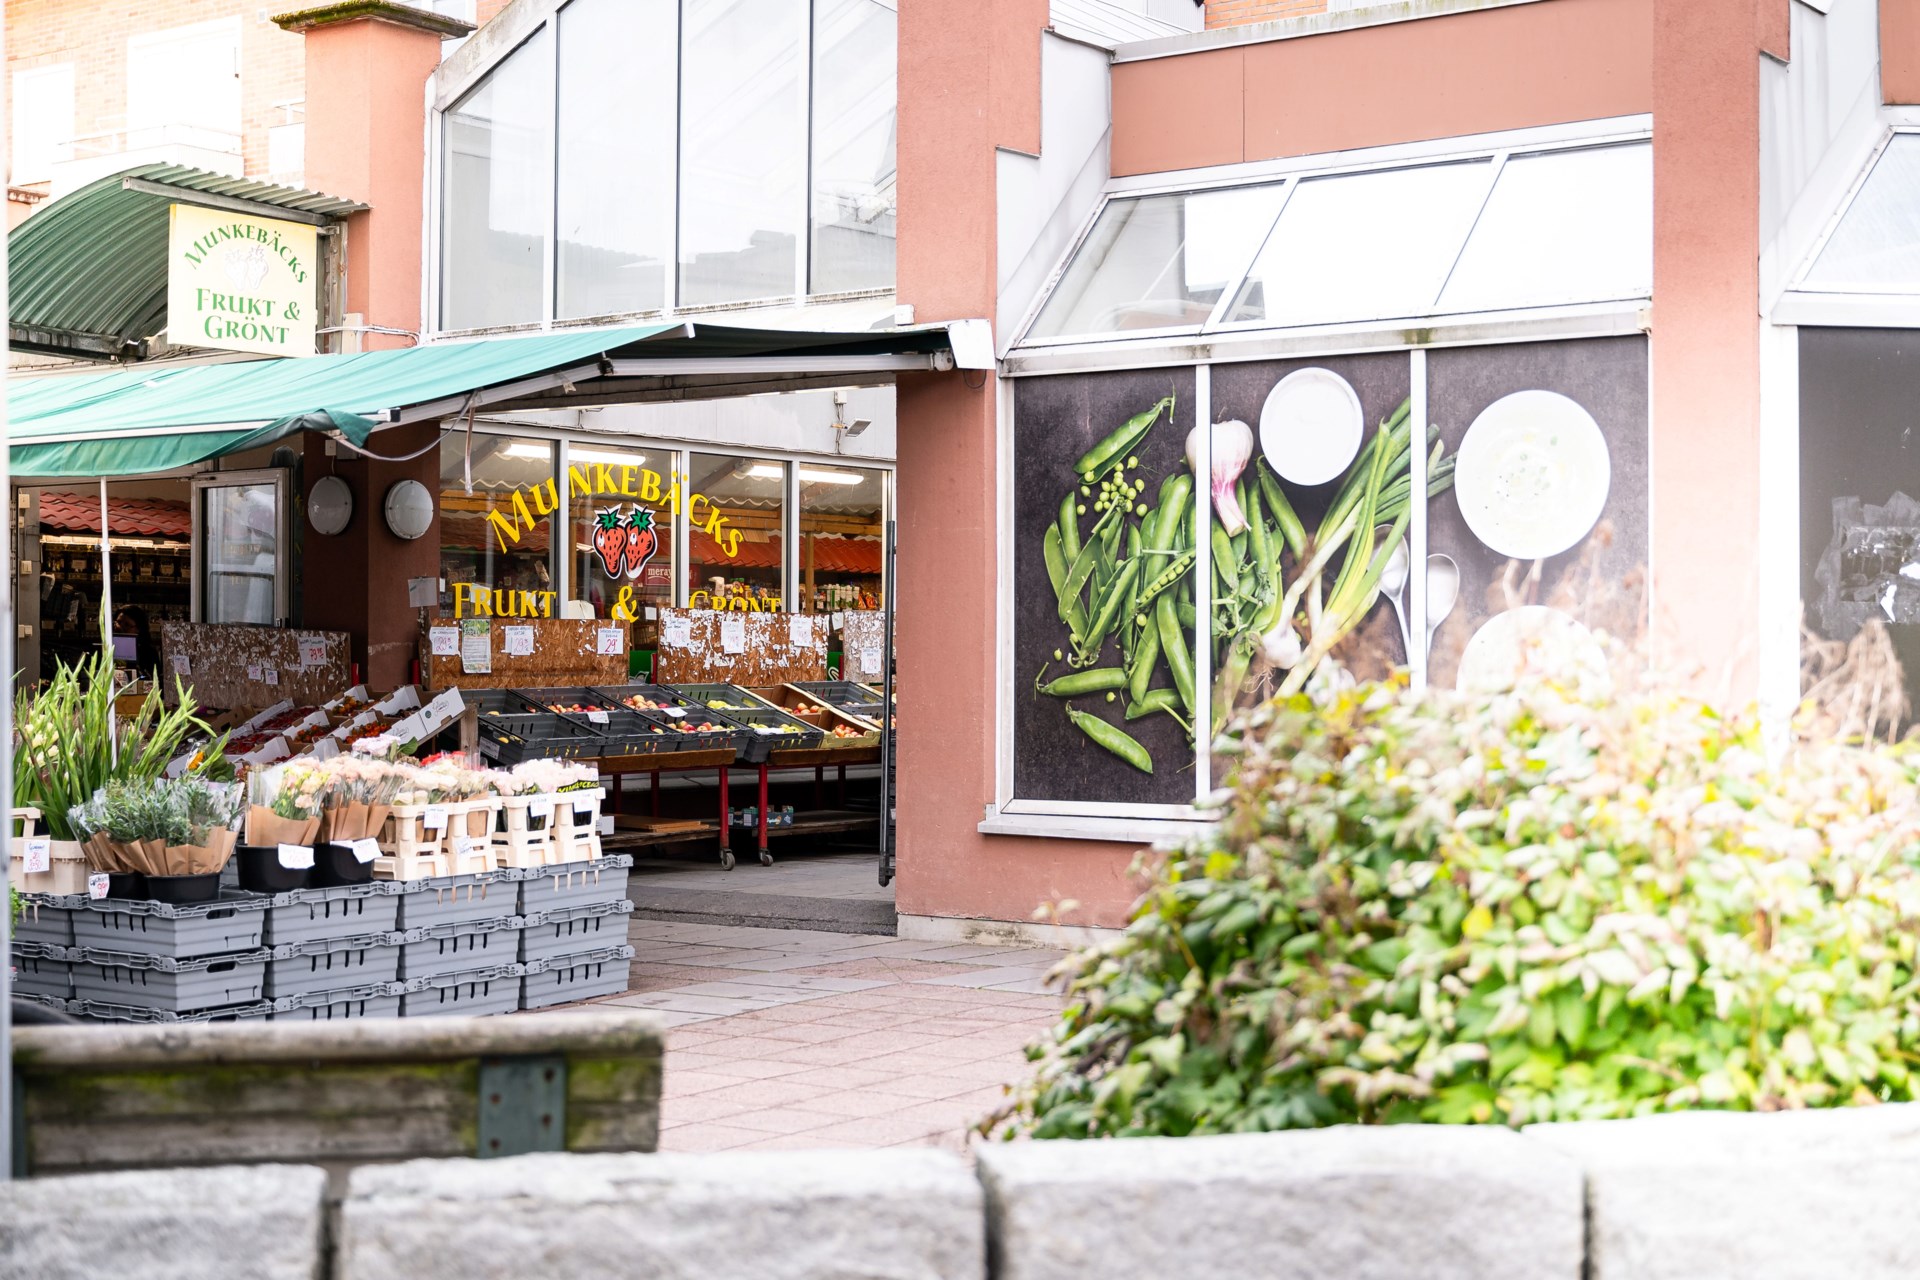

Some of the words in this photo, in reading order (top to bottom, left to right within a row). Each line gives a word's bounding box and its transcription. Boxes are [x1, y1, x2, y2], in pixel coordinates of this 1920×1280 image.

[184, 223, 307, 283] MUNKEBÄCKS
[196, 288, 276, 318] FRUKT
[284, 301, 300, 321] &
[204, 315, 290, 344] GRÖNT
[486, 463, 744, 558] MUNKEBÄCKS
[452, 582, 557, 619] FRUKT
[611, 585, 639, 623] &
